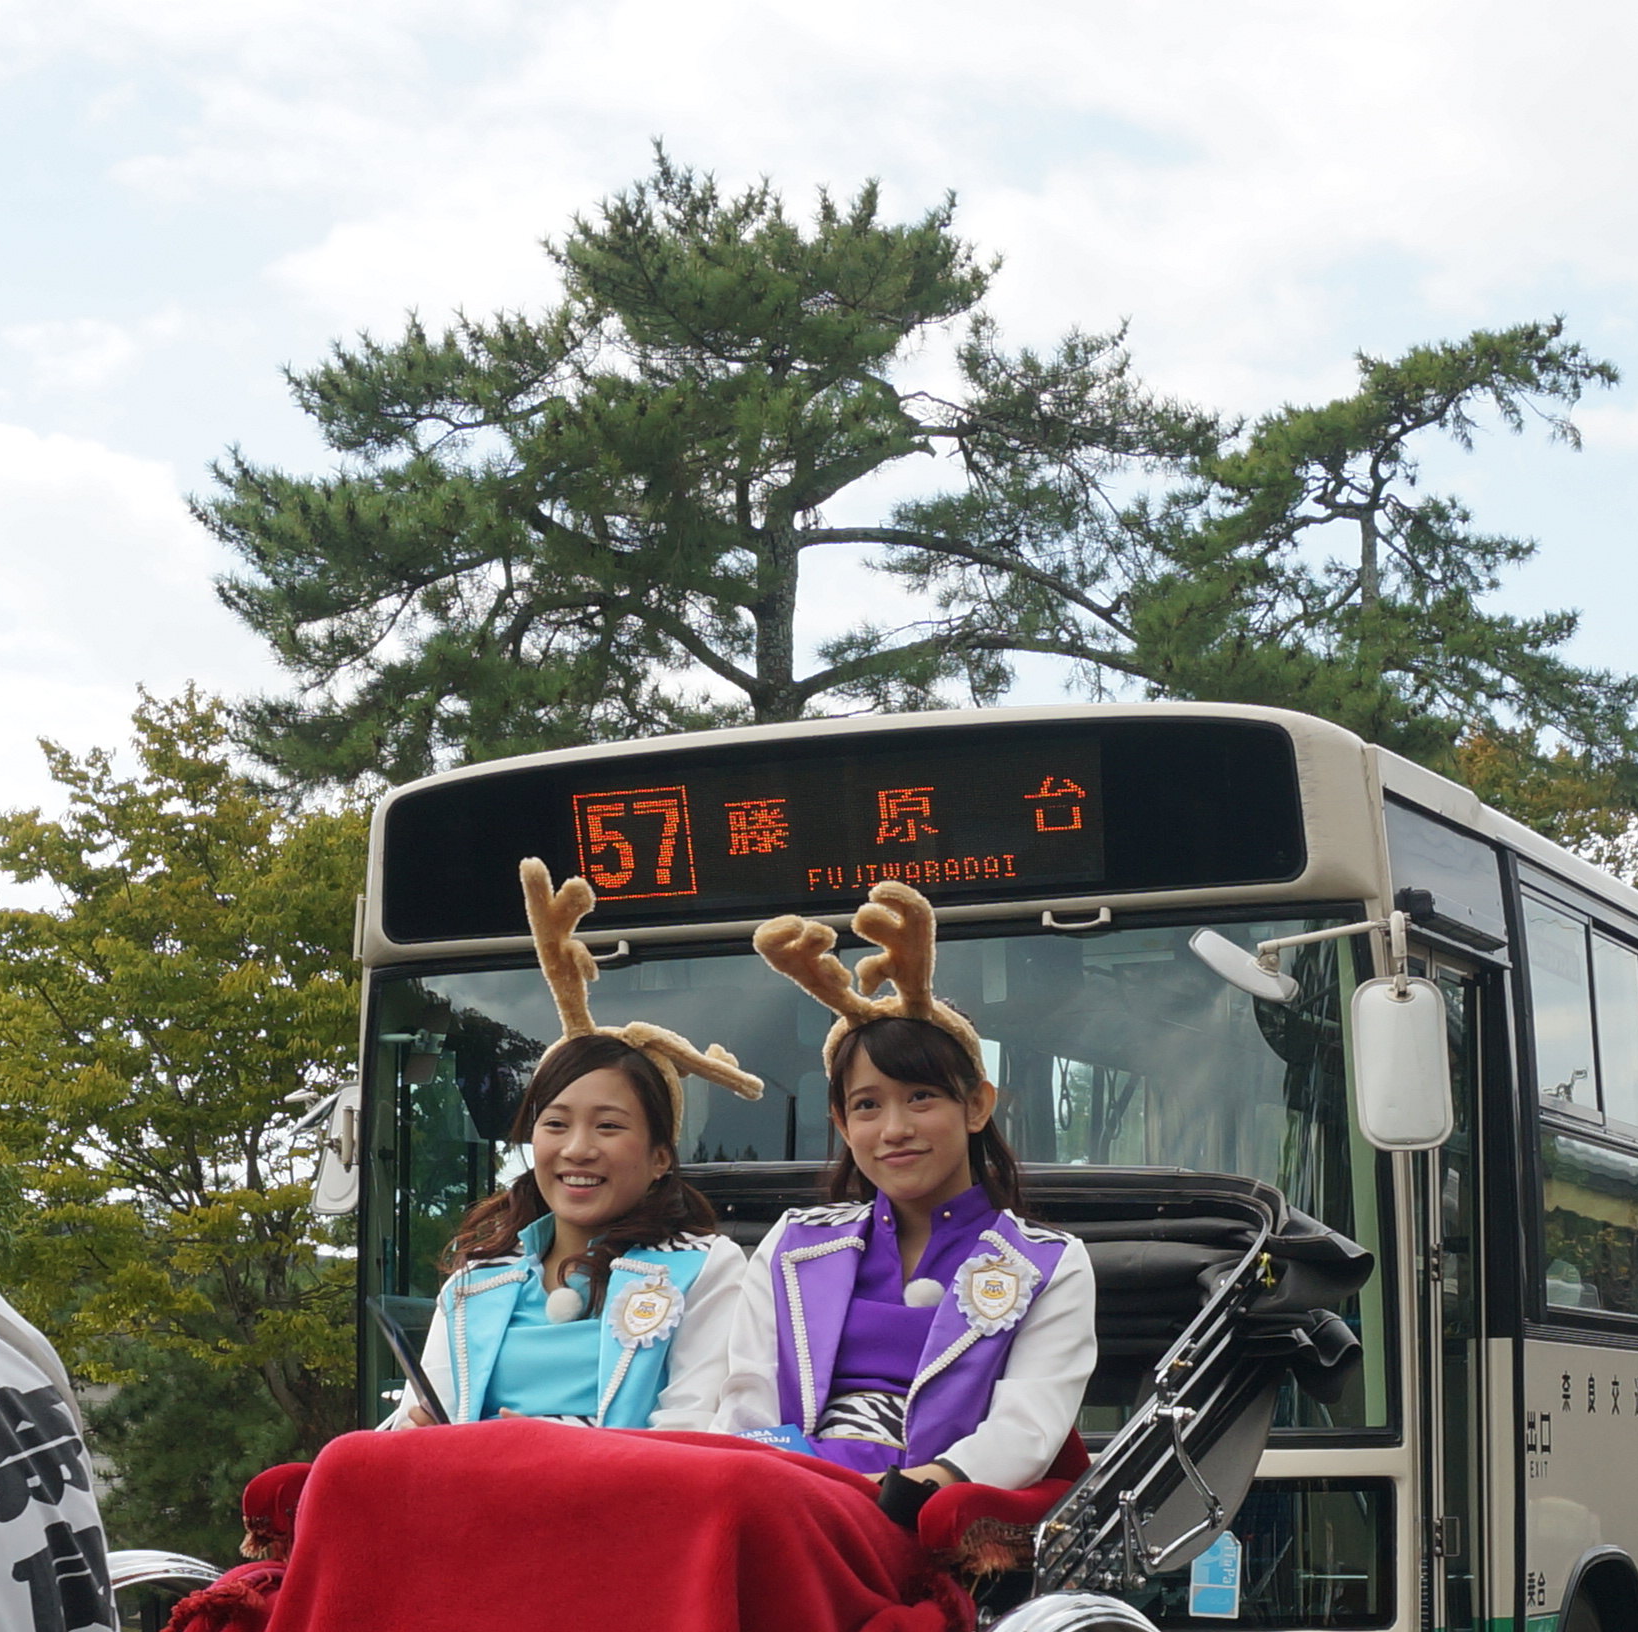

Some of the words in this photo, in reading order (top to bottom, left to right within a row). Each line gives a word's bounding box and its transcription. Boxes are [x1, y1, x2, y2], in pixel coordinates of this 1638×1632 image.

[586, 799, 679, 888] 57
[808, 854, 1016, 891] FUJIWARADAI
[1526, 1411, 1551, 1454] 出口
[1530, 1461, 1549, 1478] EXIT
